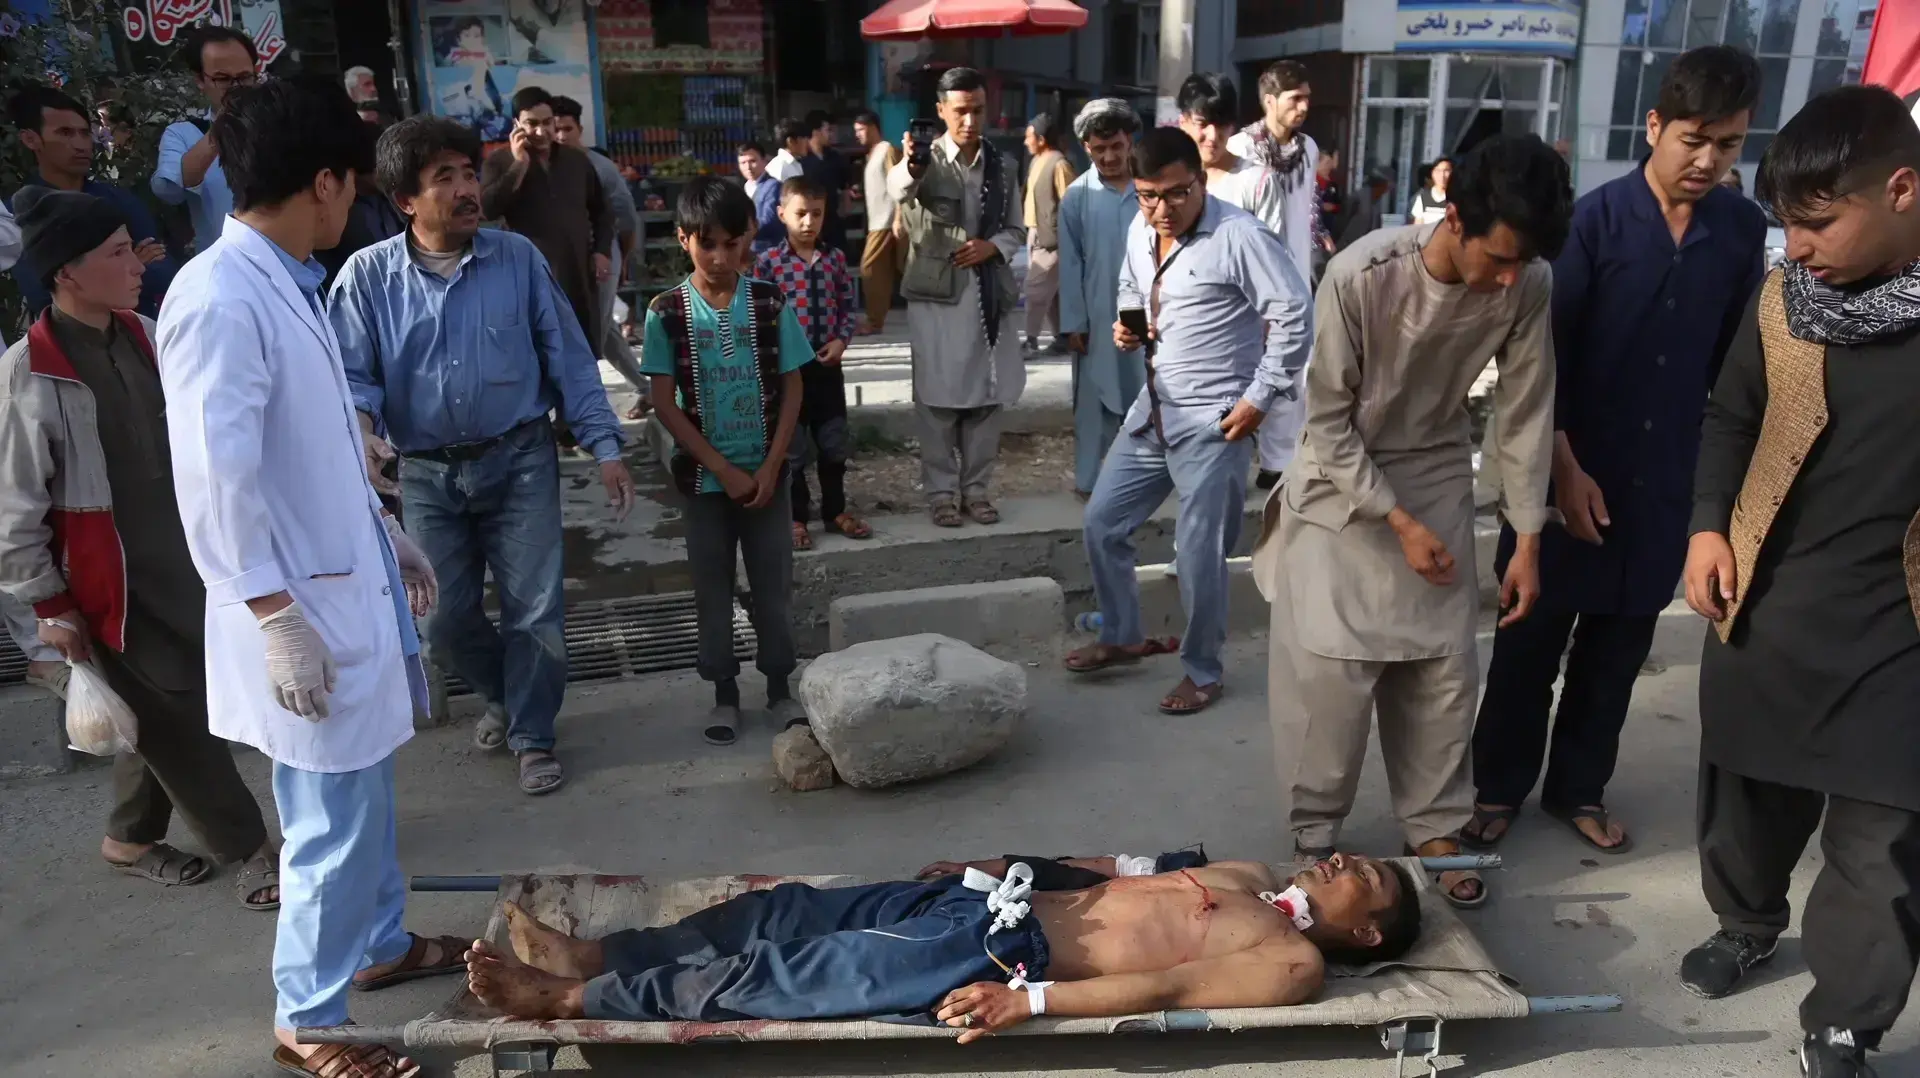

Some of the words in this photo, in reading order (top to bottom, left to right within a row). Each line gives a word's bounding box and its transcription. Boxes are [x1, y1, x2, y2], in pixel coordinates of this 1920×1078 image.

[1406, 11, 1449, 36] بلخی
[1452, 12, 1494, 37] خسرو
[1497, 14, 1526, 38] ناصر
[732, 394, 757, 417] 42
